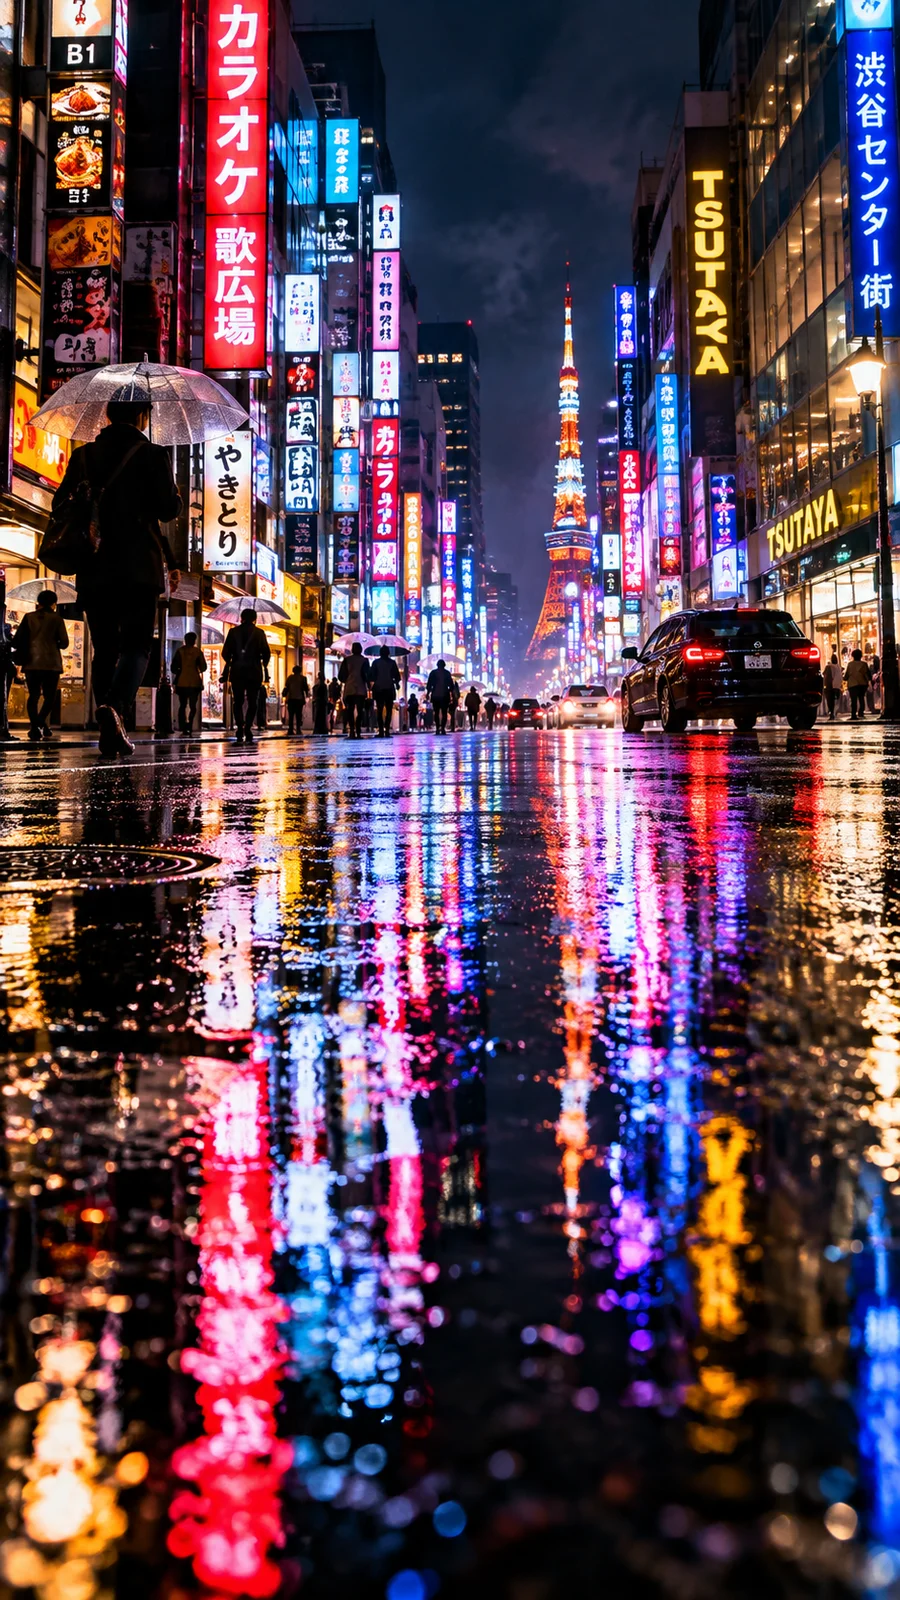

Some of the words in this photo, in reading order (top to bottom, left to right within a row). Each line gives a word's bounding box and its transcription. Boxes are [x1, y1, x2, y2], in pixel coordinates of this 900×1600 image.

[67, 43, 95, 65] B1
[215, 4, 260, 206] カラオケ
[854, 52, 893, 310] 渋谷センター街
[214, 227, 257, 346] 歌広場
[692, 170, 730, 376] TSUTAYA
[214, 444, 242, 558] やきとり
[767, 489, 839, 562] TSUTAYA
